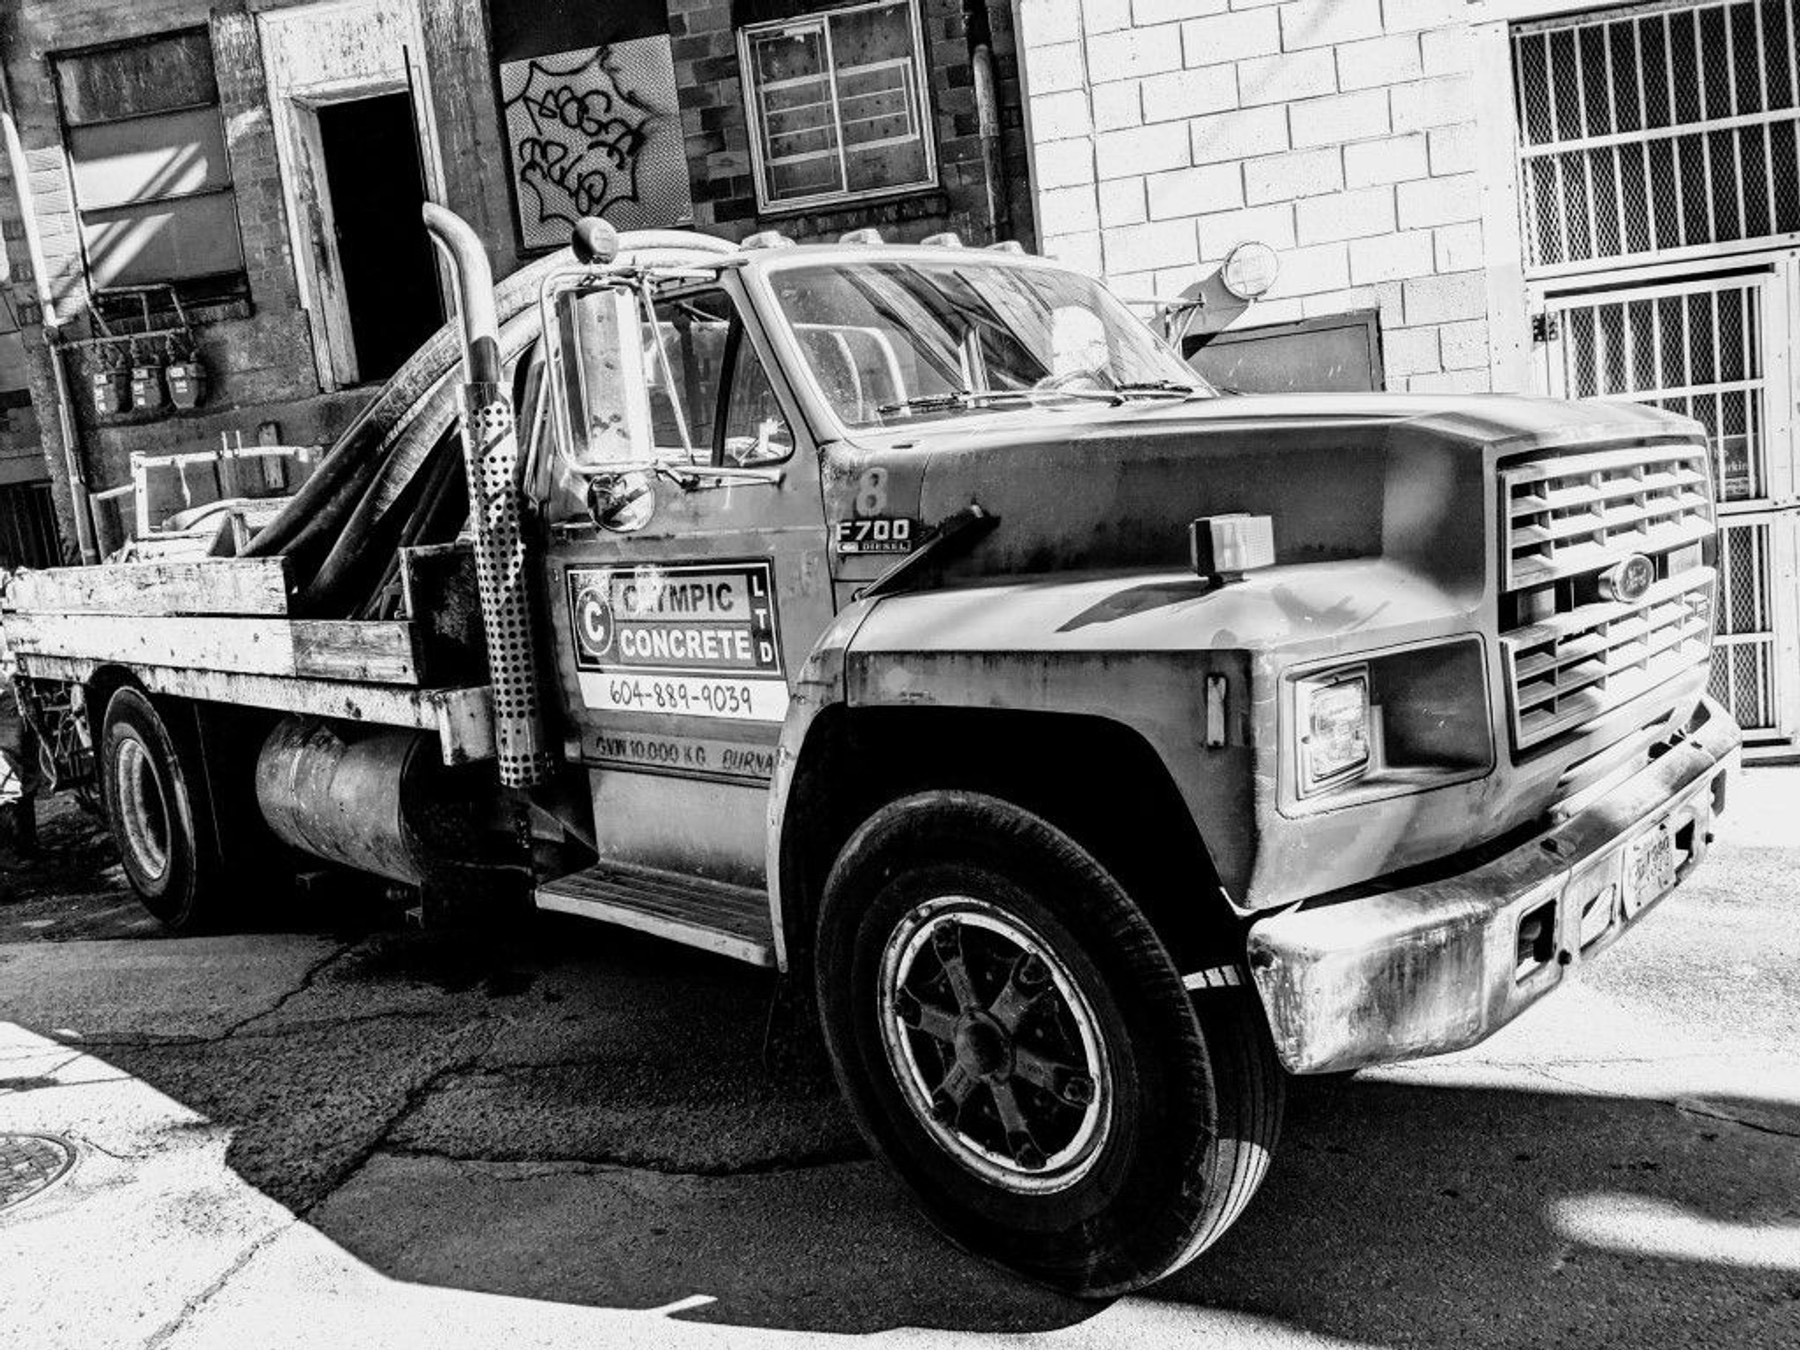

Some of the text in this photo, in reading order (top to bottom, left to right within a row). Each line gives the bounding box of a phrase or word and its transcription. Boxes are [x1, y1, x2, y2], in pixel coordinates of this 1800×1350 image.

[856, 467, 888, 517] 8
[837, 519, 909, 541] F700
[622, 582, 734, 612] OYMPIC
[583, 600, 605, 642] C
[620, 628, 752, 659] CONCRETE
[609, 680, 752, 714] 604-889-9039
